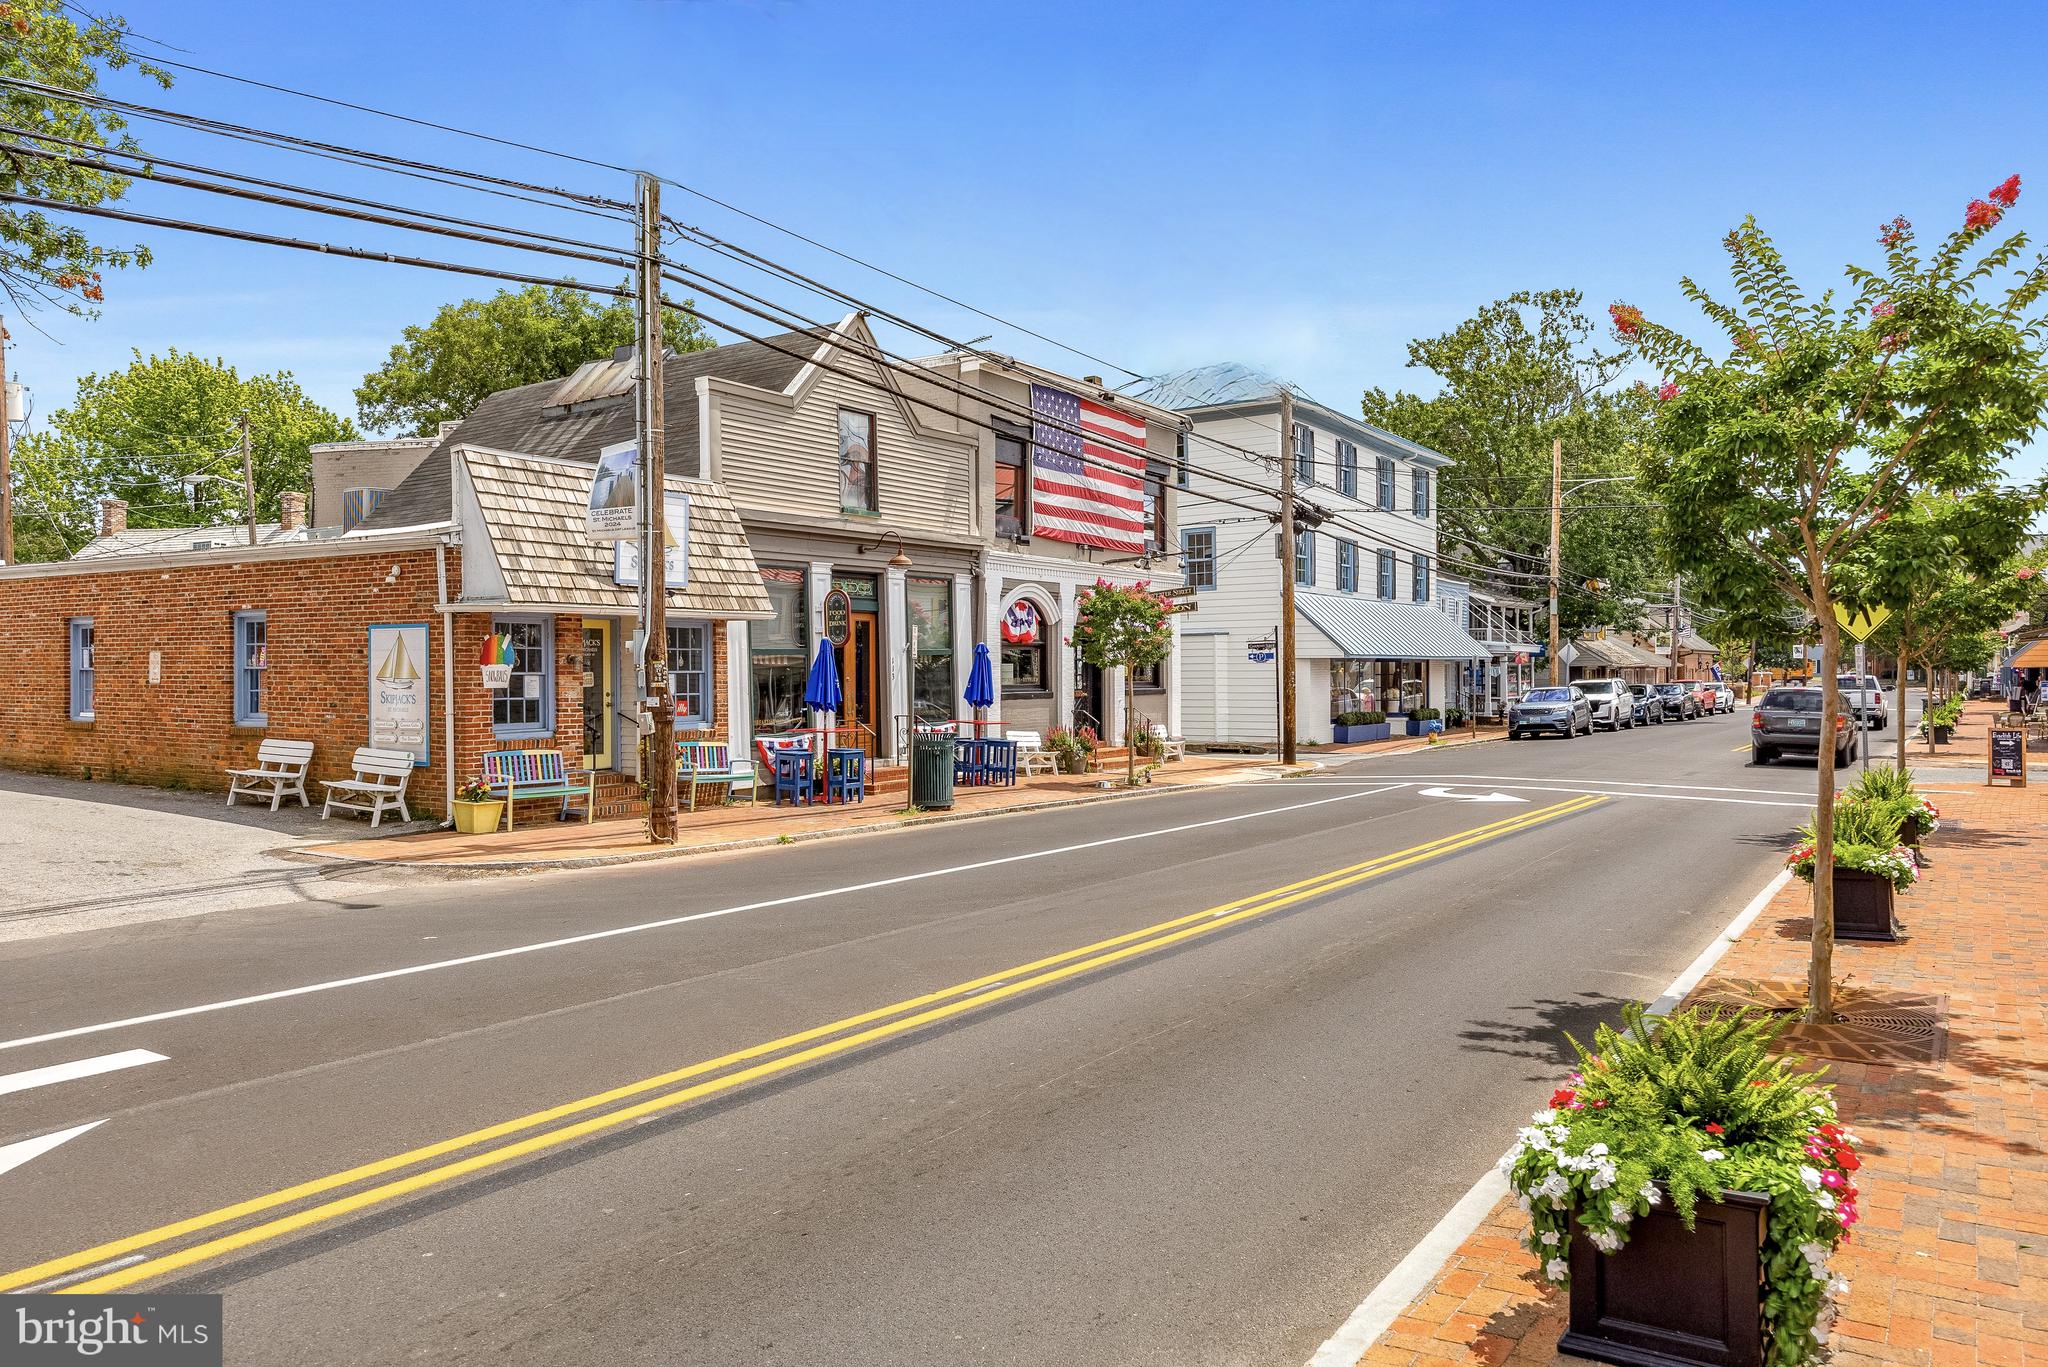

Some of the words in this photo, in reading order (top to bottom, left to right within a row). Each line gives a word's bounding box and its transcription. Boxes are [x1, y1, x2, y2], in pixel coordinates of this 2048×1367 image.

[591, 507, 633, 517] CELEBRATE
[583, 639, 600, 648] JACK'S
[380, 690, 417, 706] SKIPJACK'S
